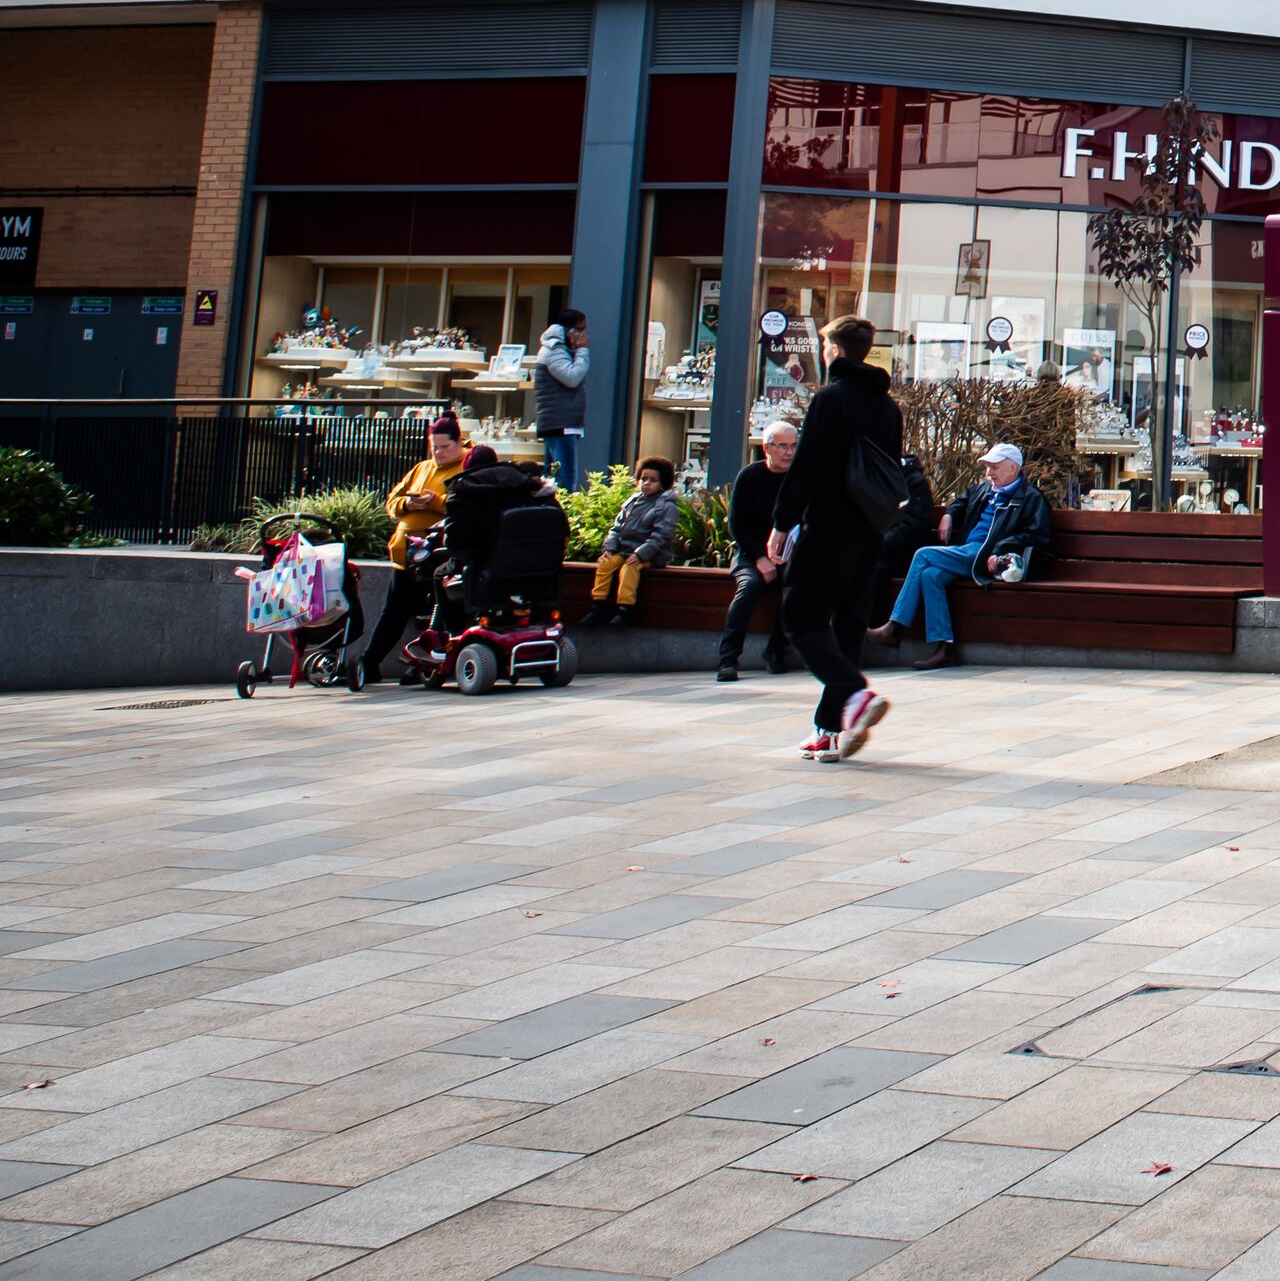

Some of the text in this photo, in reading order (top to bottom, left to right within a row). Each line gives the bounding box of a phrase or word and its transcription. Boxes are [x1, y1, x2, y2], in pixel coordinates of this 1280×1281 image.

[0, 216, 31, 237] YM
[0, 247, 28, 260] OURS
[797, 337, 819, 345] GOOD
